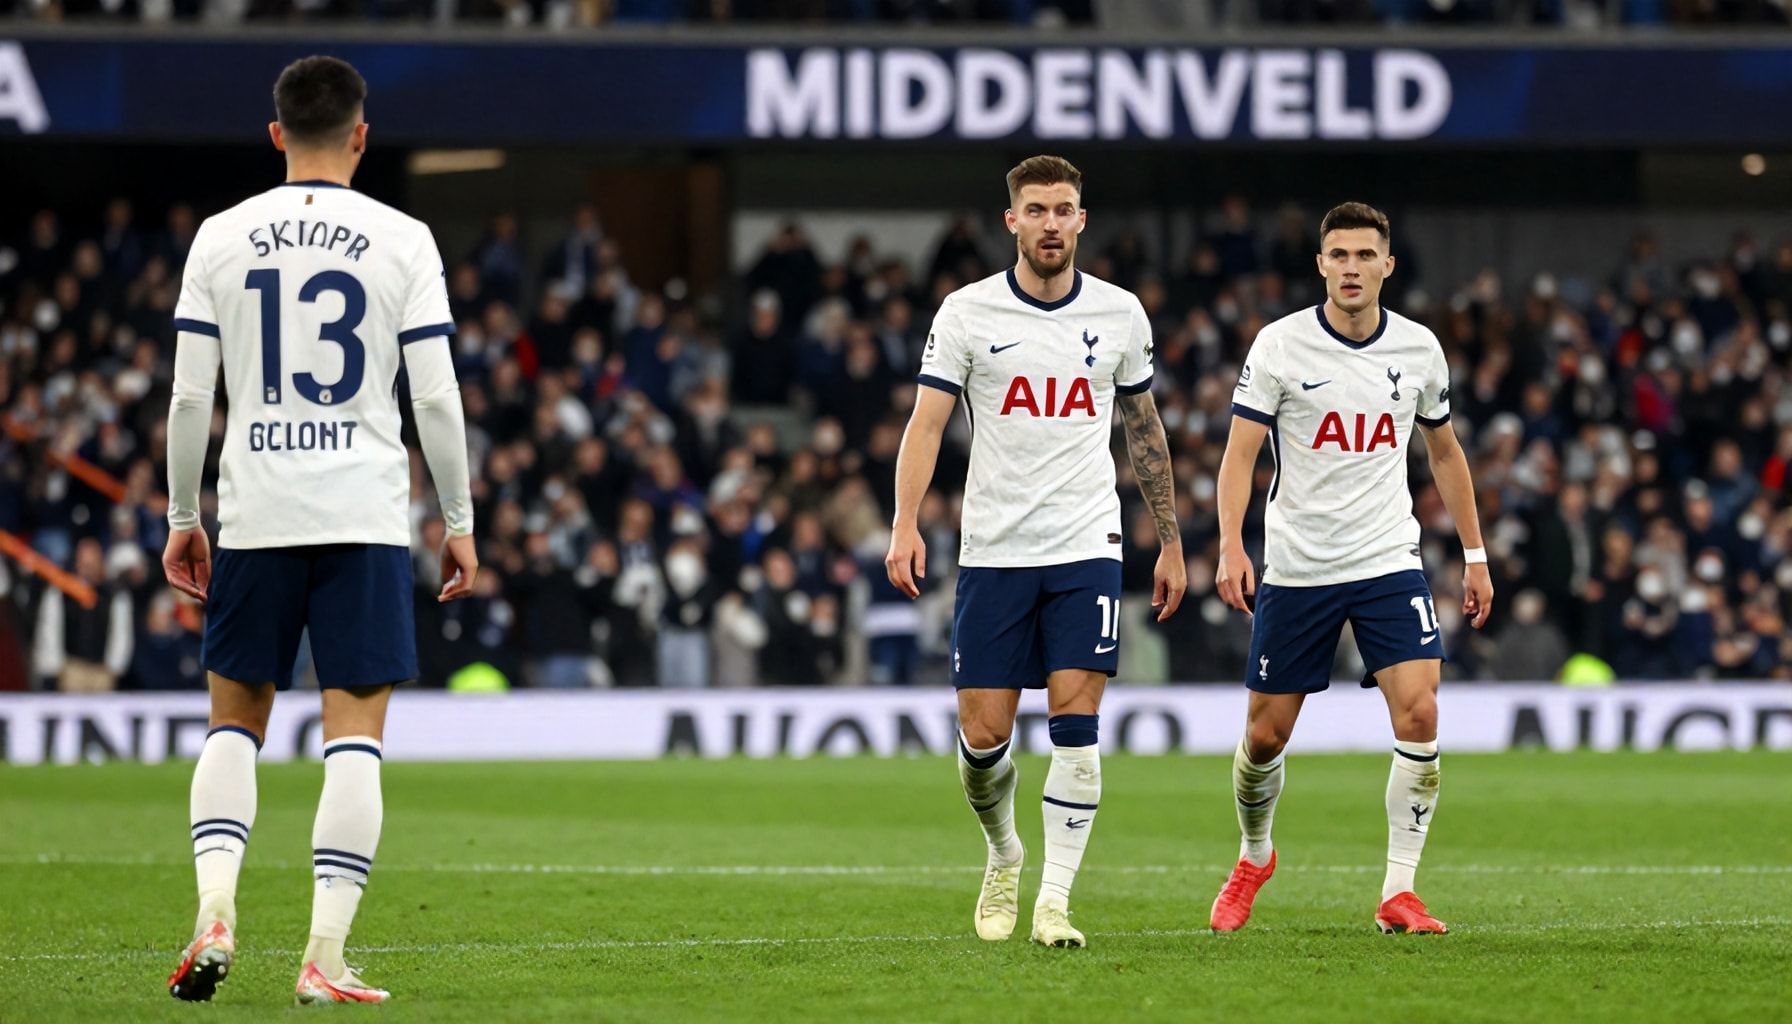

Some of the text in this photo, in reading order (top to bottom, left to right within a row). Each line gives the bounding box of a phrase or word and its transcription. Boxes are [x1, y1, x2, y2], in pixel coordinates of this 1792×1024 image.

[746, 50, 1451, 139] MIDDENVELD
[245, 268, 366, 406] 13
[1000, 376, 1096, 417] AIA
[1312, 411, 1397, 452] AIA
